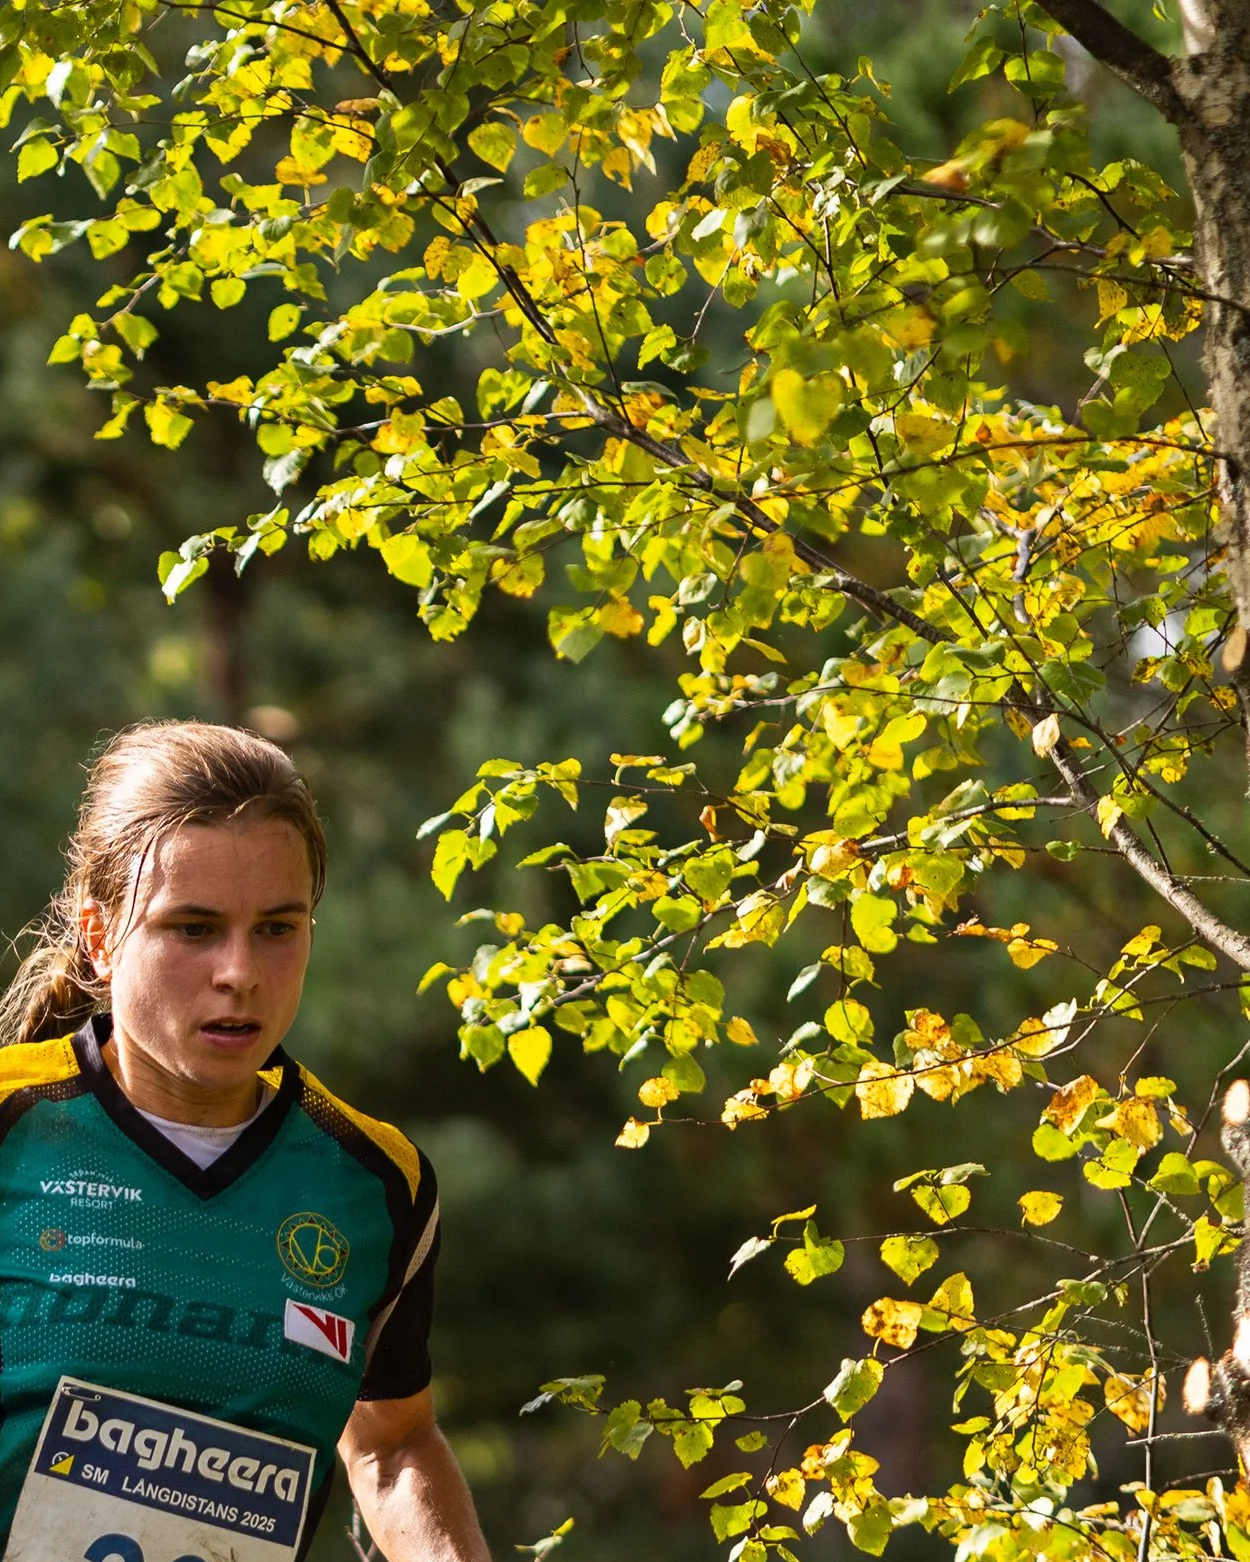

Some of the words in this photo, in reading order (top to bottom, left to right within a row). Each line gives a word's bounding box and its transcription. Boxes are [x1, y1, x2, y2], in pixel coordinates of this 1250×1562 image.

[39, 1180, 143, 1201] VÄSTERVIK
[70, 1197, 114, 1210] RESORT
[67, 1232, 143, 1250] topformula
[61, 1399, 301, 1503] bagheera
[81, 1463, 110, 1485] SM
[121, 1475, 239, 1523] LÅNGDISTANS
[240, 1510, 277, 1534] 2025
